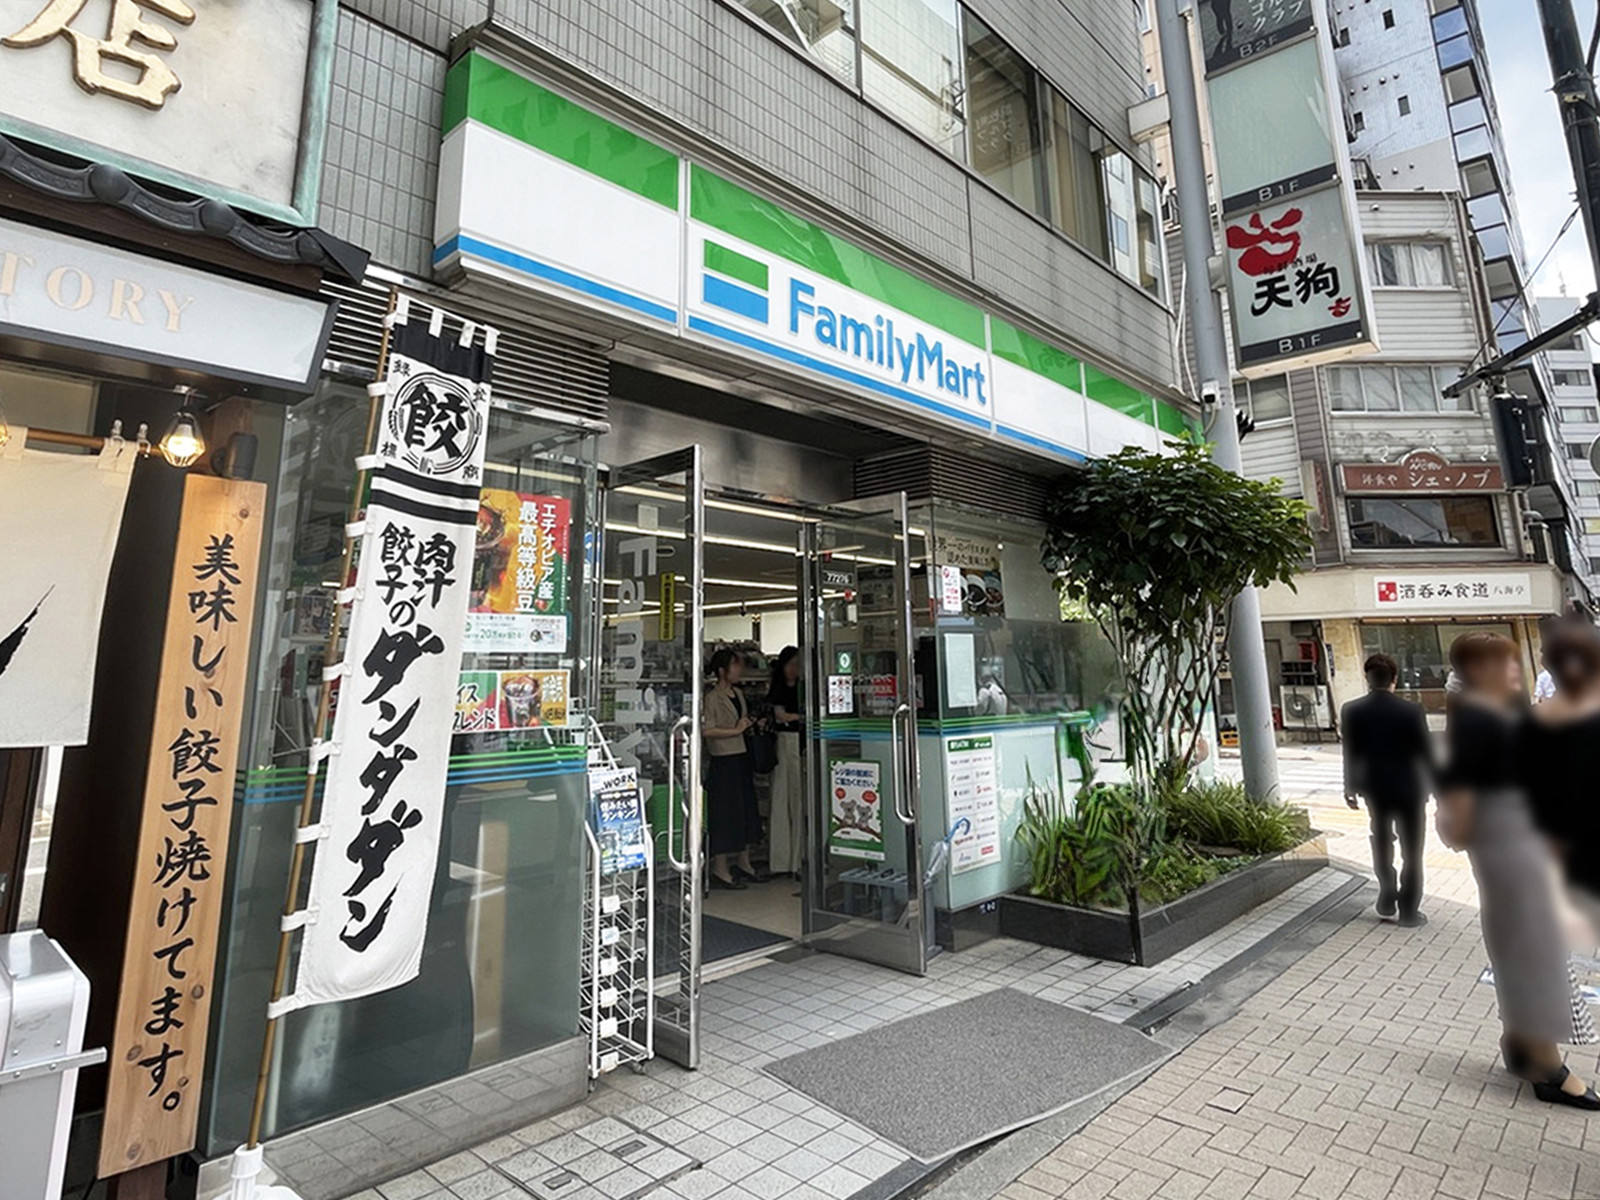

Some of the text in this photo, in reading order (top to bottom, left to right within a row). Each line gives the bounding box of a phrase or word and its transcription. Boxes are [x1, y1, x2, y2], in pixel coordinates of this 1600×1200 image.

[1240, 34, 1278, 58] B2F
[1259, 180, 1300, 201] B1F
[0, 251, 194, 333] TORY
[1251, 263, 1340, 317] 天狗
[788, 277, 986, 406] FamilyMart
[1278, 334, 1321, 353] B1F
[401, 382, 469, 459] 餃
[1409, 468, 1490, 487] シェ・ノブ
[375, 521, 416, 627] 餃子の
[410, 532, 457, 609] 肉汁
[514, 500, 539, 613] 最高等級豆
[538, 503, 557, 600] エチオピア産
[1400, 582, 1489, 599] 酒呑み食道
[138, 533, 243, 1112] 美味しい餃子焼けてます。
[339, 623, 446, 953] ダンダダン
